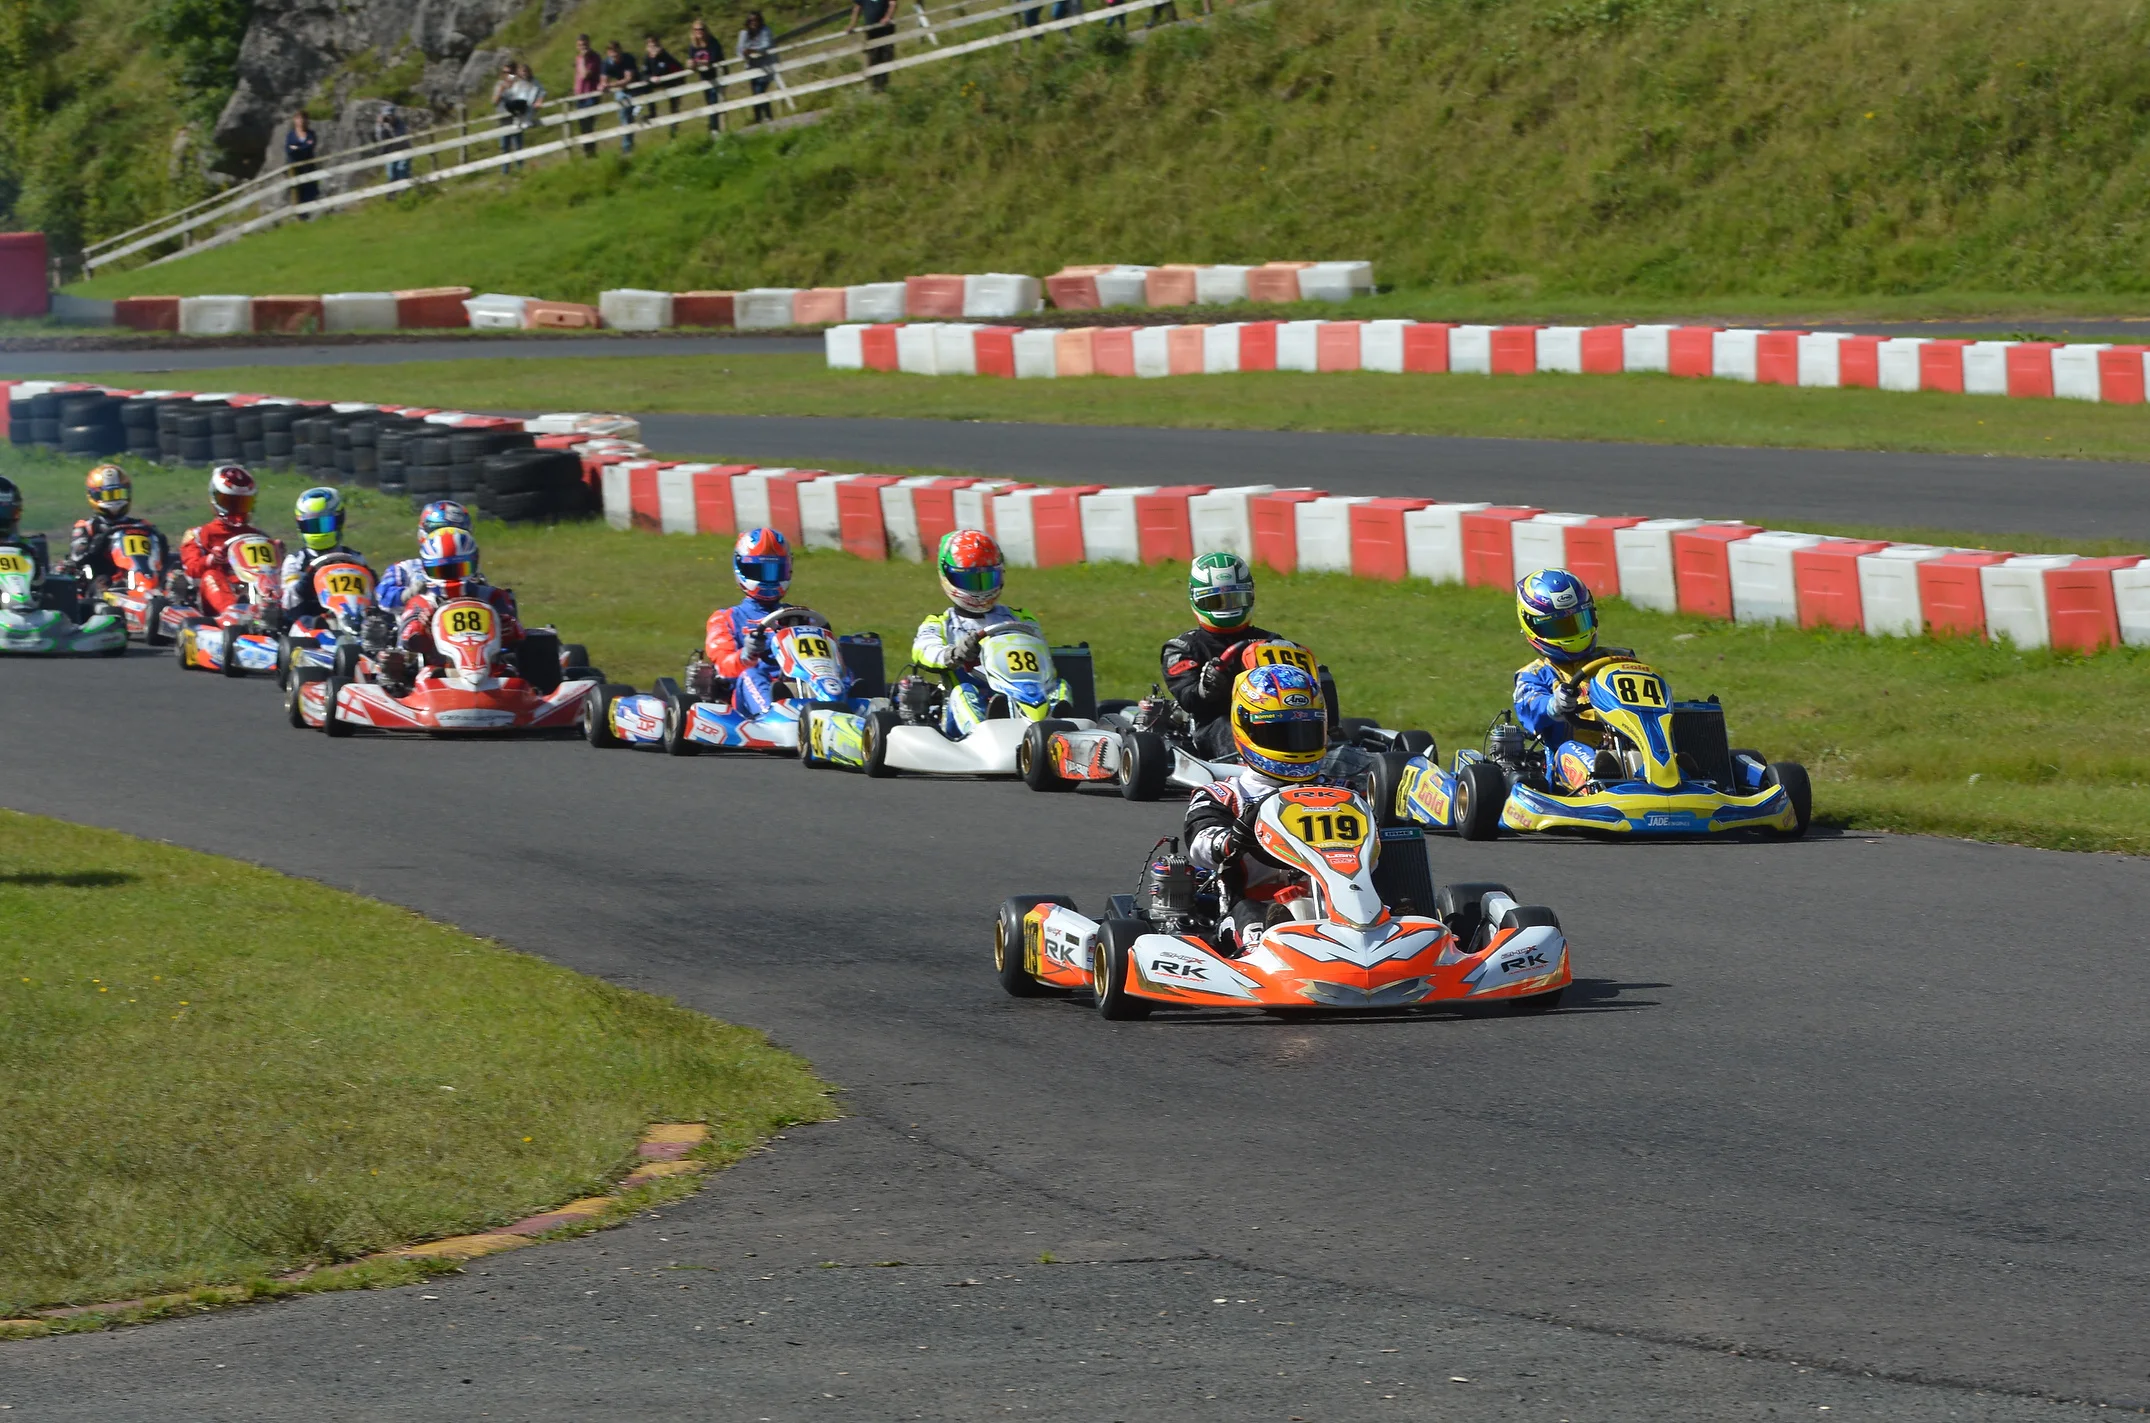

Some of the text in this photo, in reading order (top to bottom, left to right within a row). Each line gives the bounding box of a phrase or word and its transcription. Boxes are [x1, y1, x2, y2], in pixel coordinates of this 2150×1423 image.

[247, 546, 272, 563] 79
[330, 576, 365, 594] 124
[453, 611, 482, 631] 88
[798, 638, 831, 658] 49
[1008, 651, 1039, 672] 38
[1621, 664, 1650, 672] Gold
[1285, 695, 1309, 705] Arai
[1617, 677, 1662, 705] 84
[1418, 782, 1446, 817] Gold
[1506, 805, 1532, 828] Gold
[1647, 815, 1669, 826] JADE
[1297, 815, 1361, 842] 119
[1045, 938, 1077, 965] RK
[1151, 960, 1211, 981] RK
[1501, 952, 1549, 973] RK
